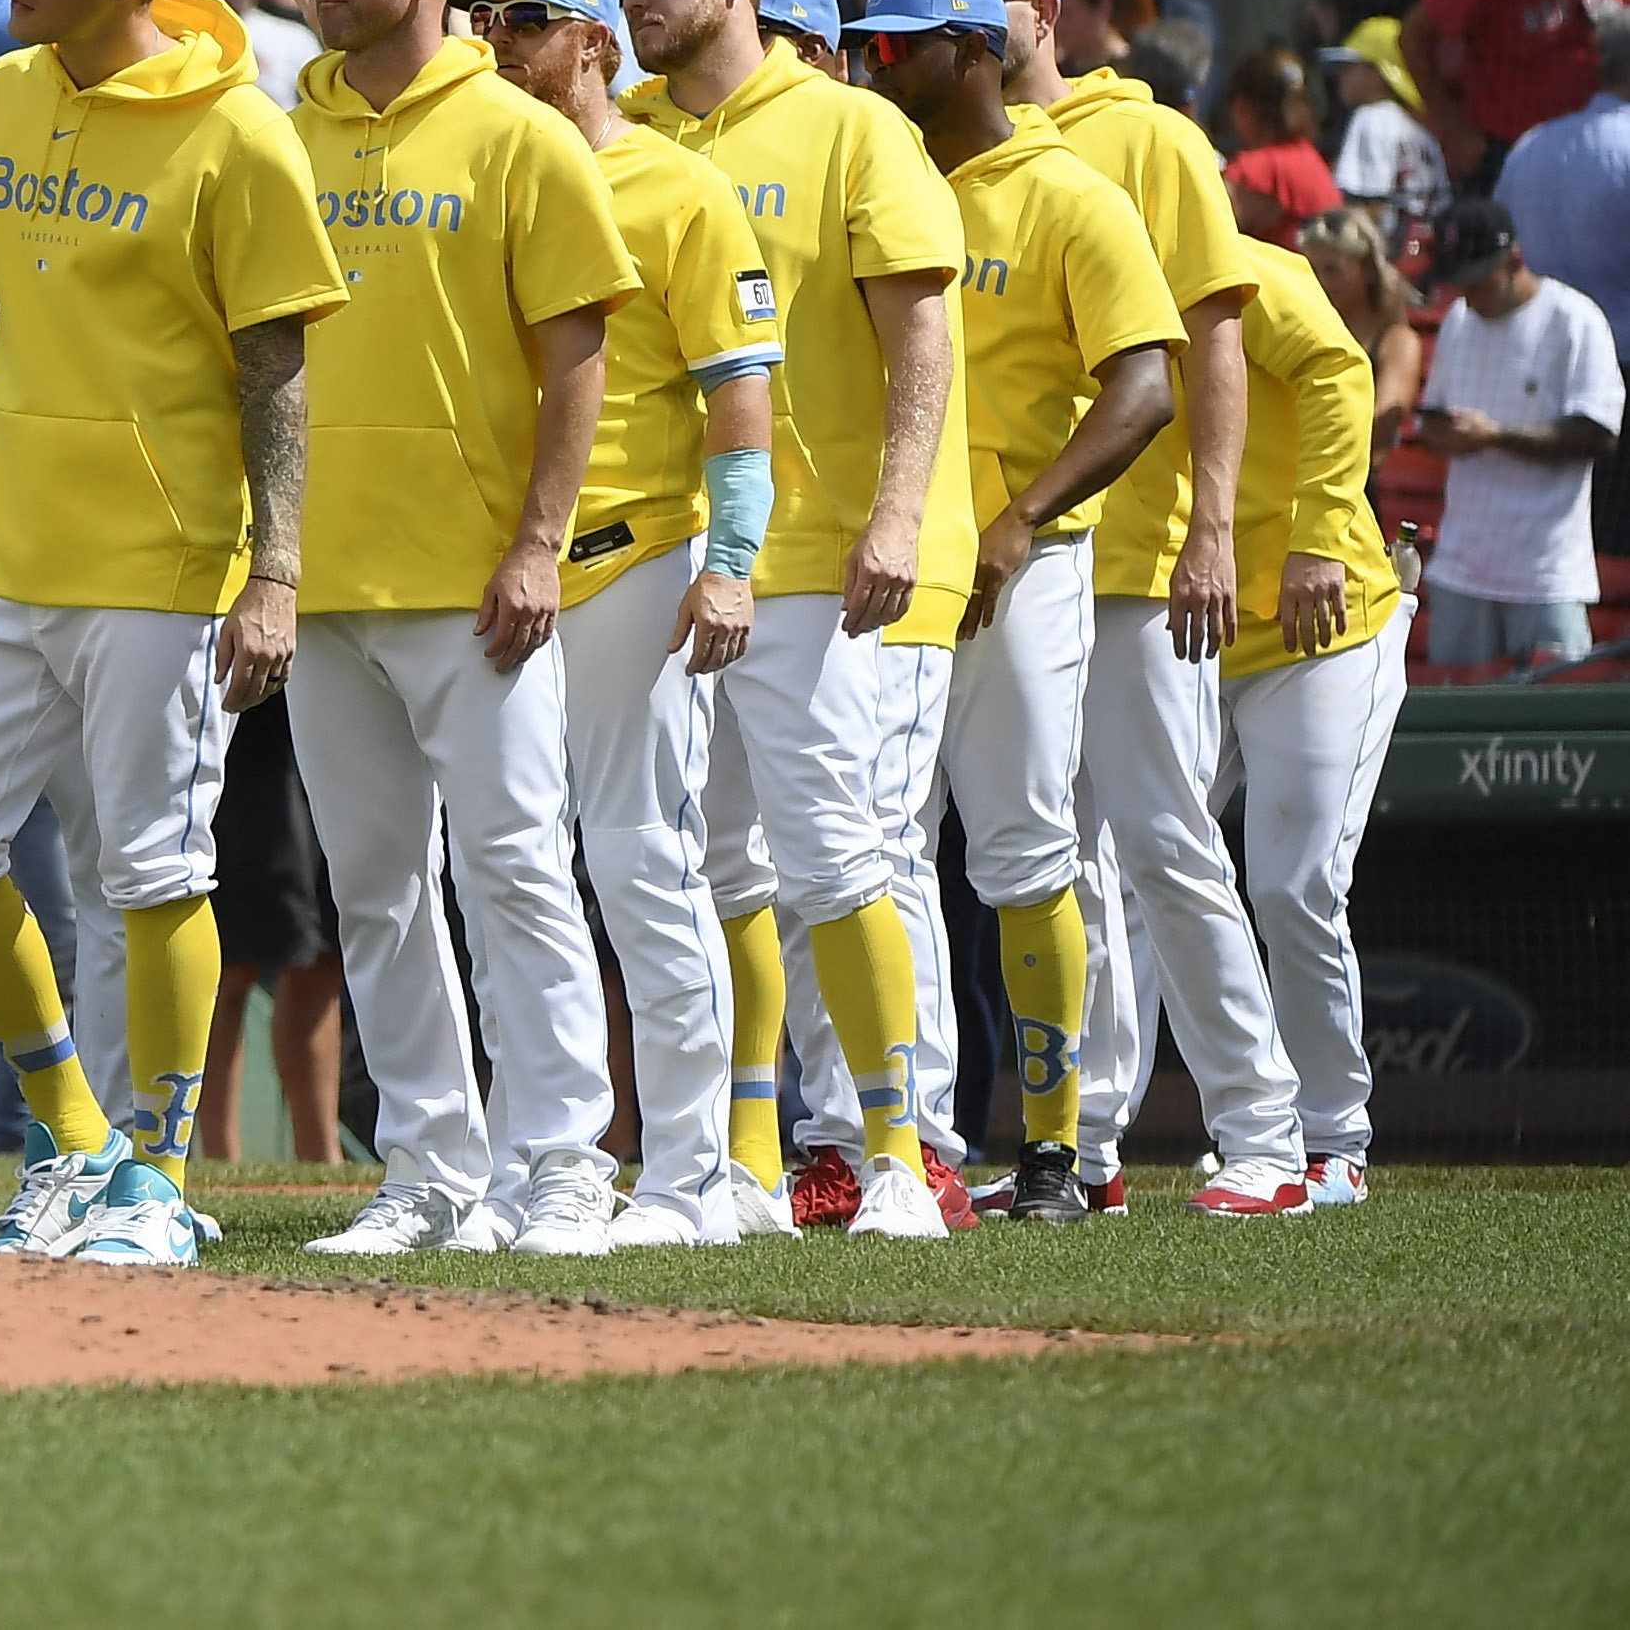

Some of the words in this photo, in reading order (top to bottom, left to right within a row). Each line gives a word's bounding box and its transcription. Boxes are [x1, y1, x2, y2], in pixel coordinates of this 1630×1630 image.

[753, 282, 770, 306] 617
[1459, 737, 1597, 796] xfinity
[1017, 1017, 1069, 1097] B
